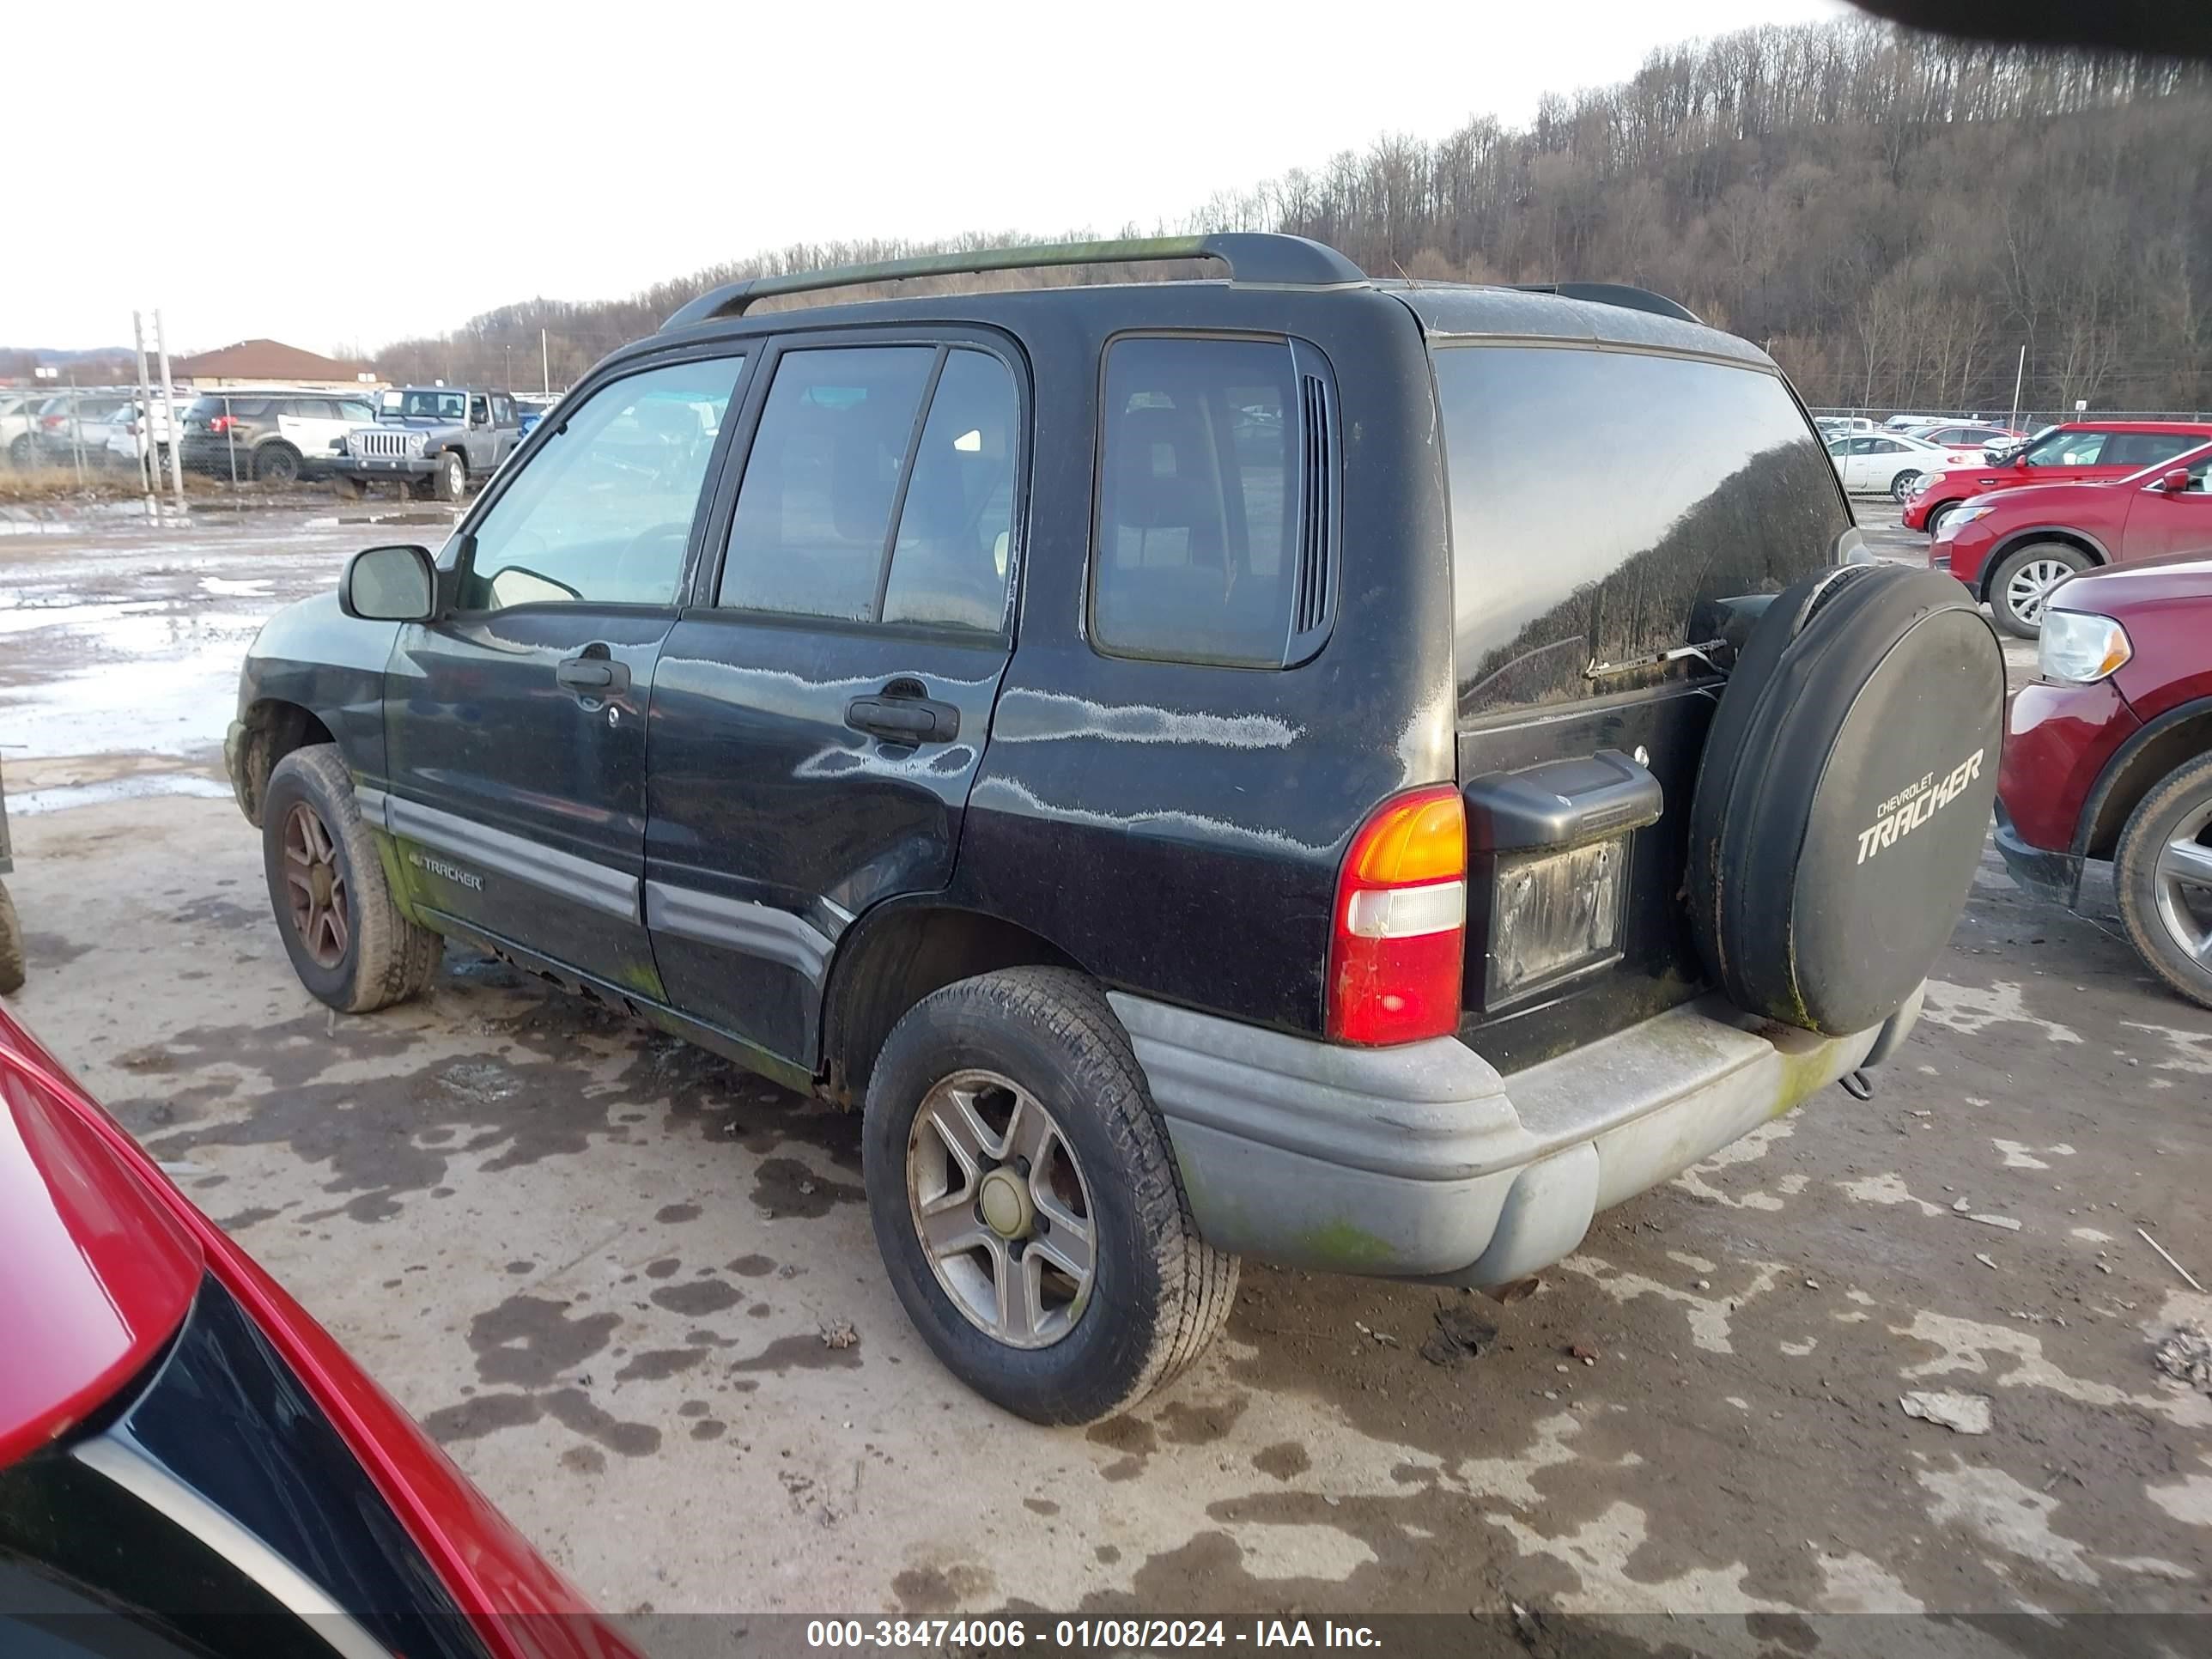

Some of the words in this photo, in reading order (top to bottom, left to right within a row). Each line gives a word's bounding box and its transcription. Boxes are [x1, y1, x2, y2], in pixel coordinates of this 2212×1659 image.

[1857, 748, 1984, 865] TRACKER
[1877, 771, 1934, 818] CHEVROLET
[424, 857, 483, 890] TRACKER
